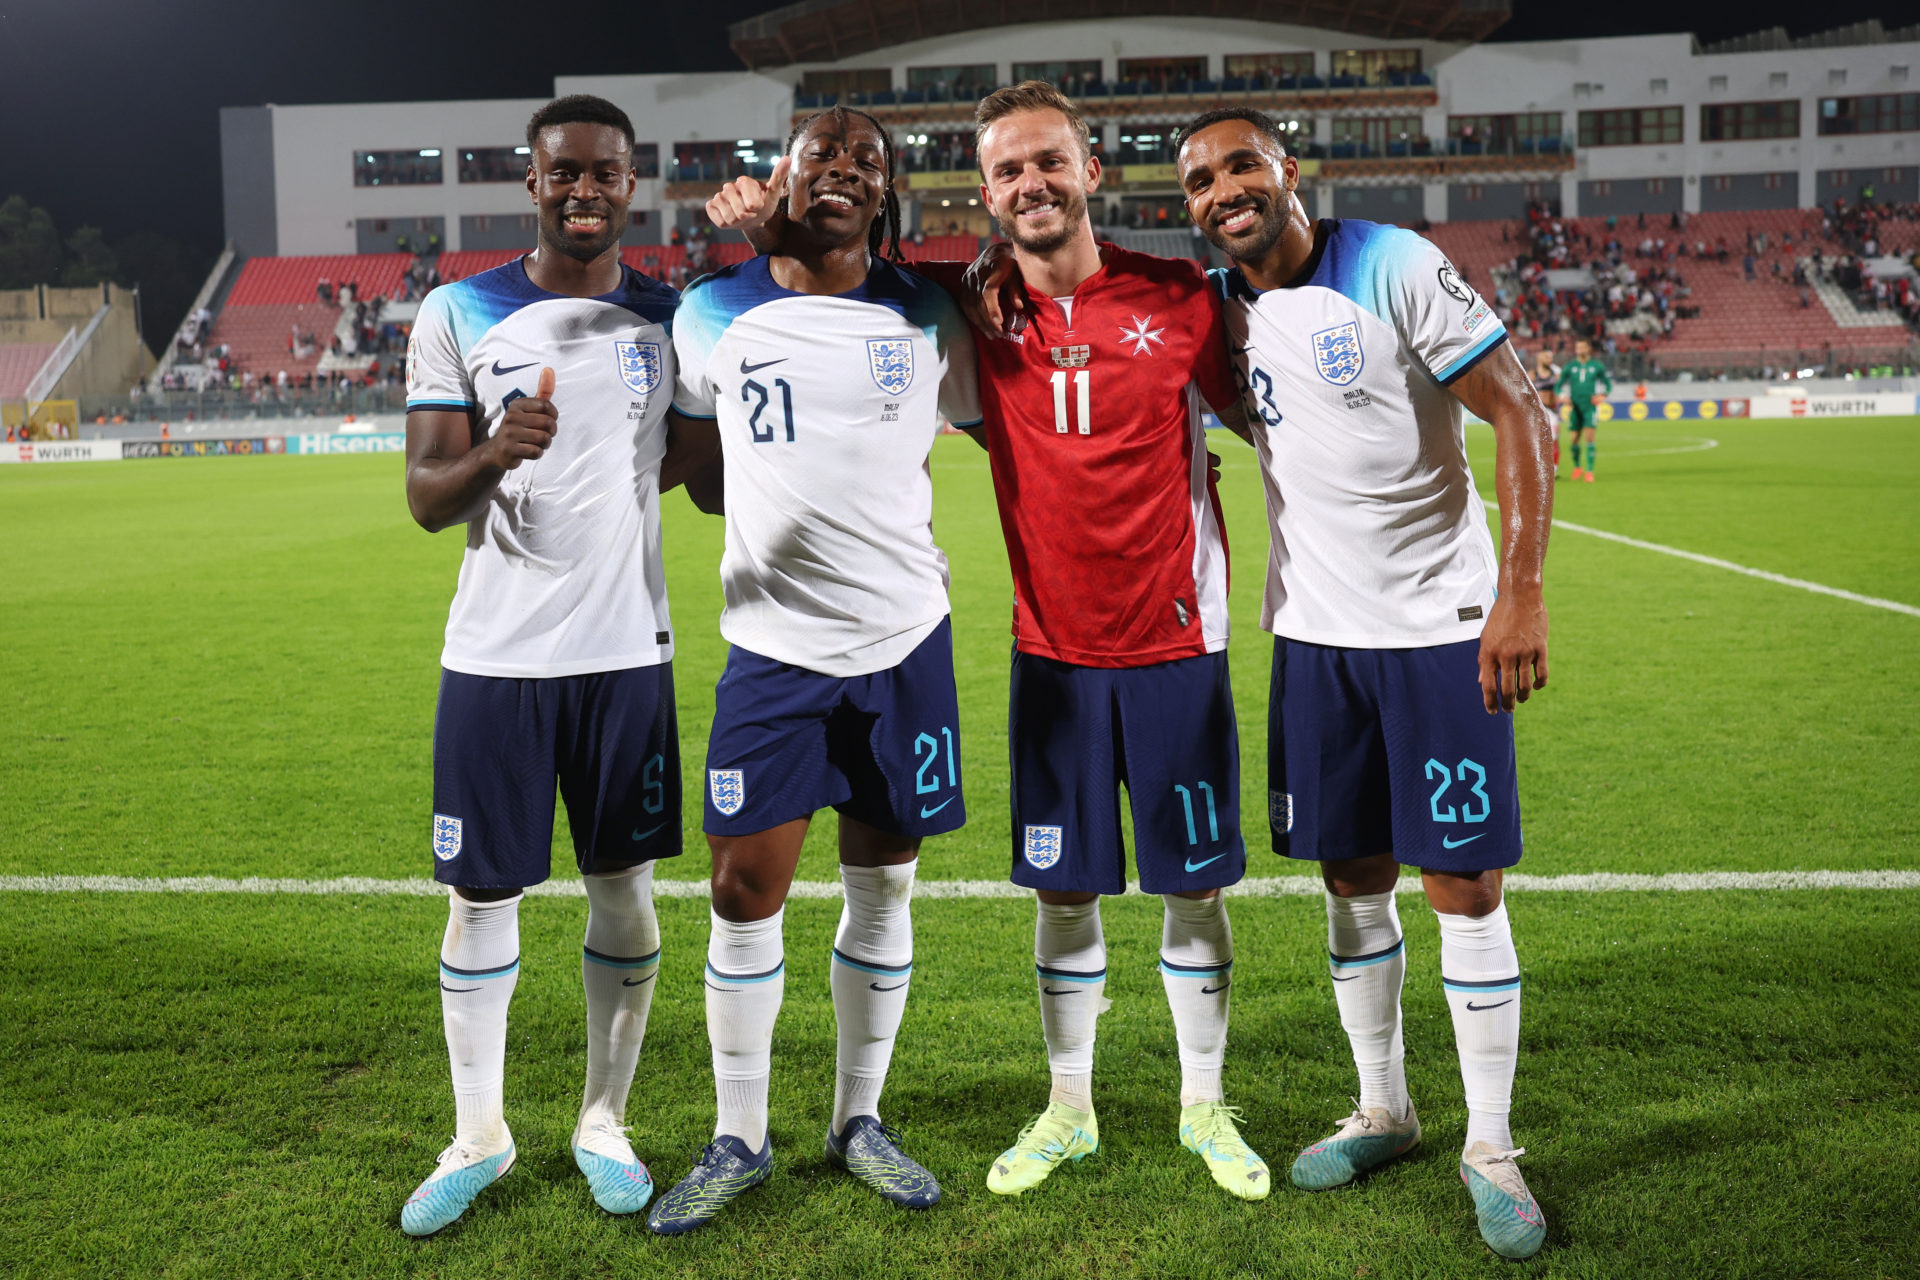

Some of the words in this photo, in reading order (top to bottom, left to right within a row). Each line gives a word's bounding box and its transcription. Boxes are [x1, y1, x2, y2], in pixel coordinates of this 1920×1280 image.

[630, 401, 649, 411] MALTA
[741, 378, 795, 443] 21
[1049, 370, 1091, 435] 11
[1343, 388, 1366, 400] MALTA
[1346, 397, 1371, 410] 16.06.23
[123, 442, 160, 457] UEFA
[161, 439, 264, 457] FOUNDATION
[643, 753, 664, 814] 5
[914, 726, 956, 795] 21
[1424, 758, 1491, 823] 23
[1174, 780, 1219, 845] 11
